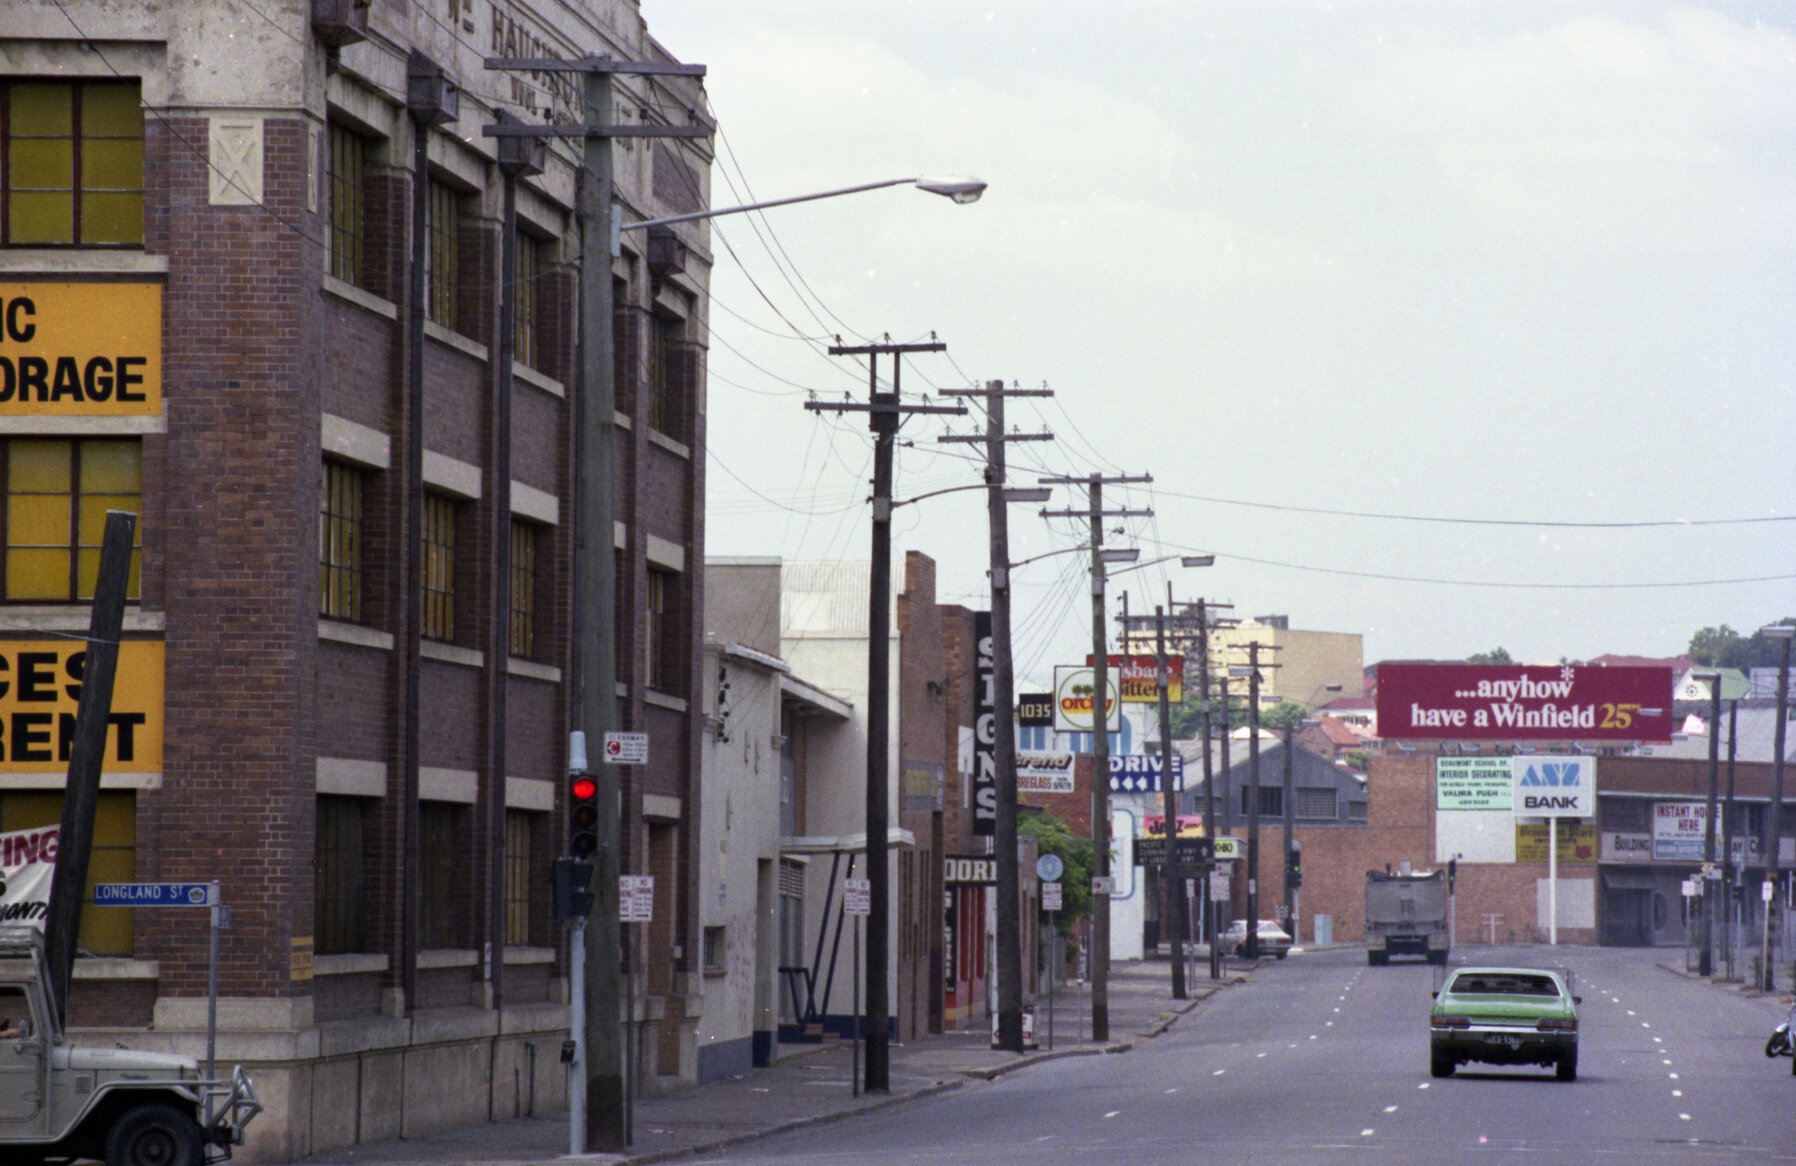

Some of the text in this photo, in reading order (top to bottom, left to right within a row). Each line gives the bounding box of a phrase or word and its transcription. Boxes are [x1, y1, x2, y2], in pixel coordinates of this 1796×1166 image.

[1020, 703, 1051, 718] 1035
[1411, 703, 1467, 727] have
[1474, 709, 1488, 727] a
[1491, 703, 1595, 728] Winfield
[1439, 770, 1469, 779] INTERIOR
[1520, 763, 1580, 786] ANZ
[1524, 796, 1578, 808] BANK
[1656, 806, 1721, 818] INSTANT HOE
[1678, 820, 1699, 831] HERE
[0, 830, 59, 867] ING
[95, 886, 161, 900] LONGLAND
